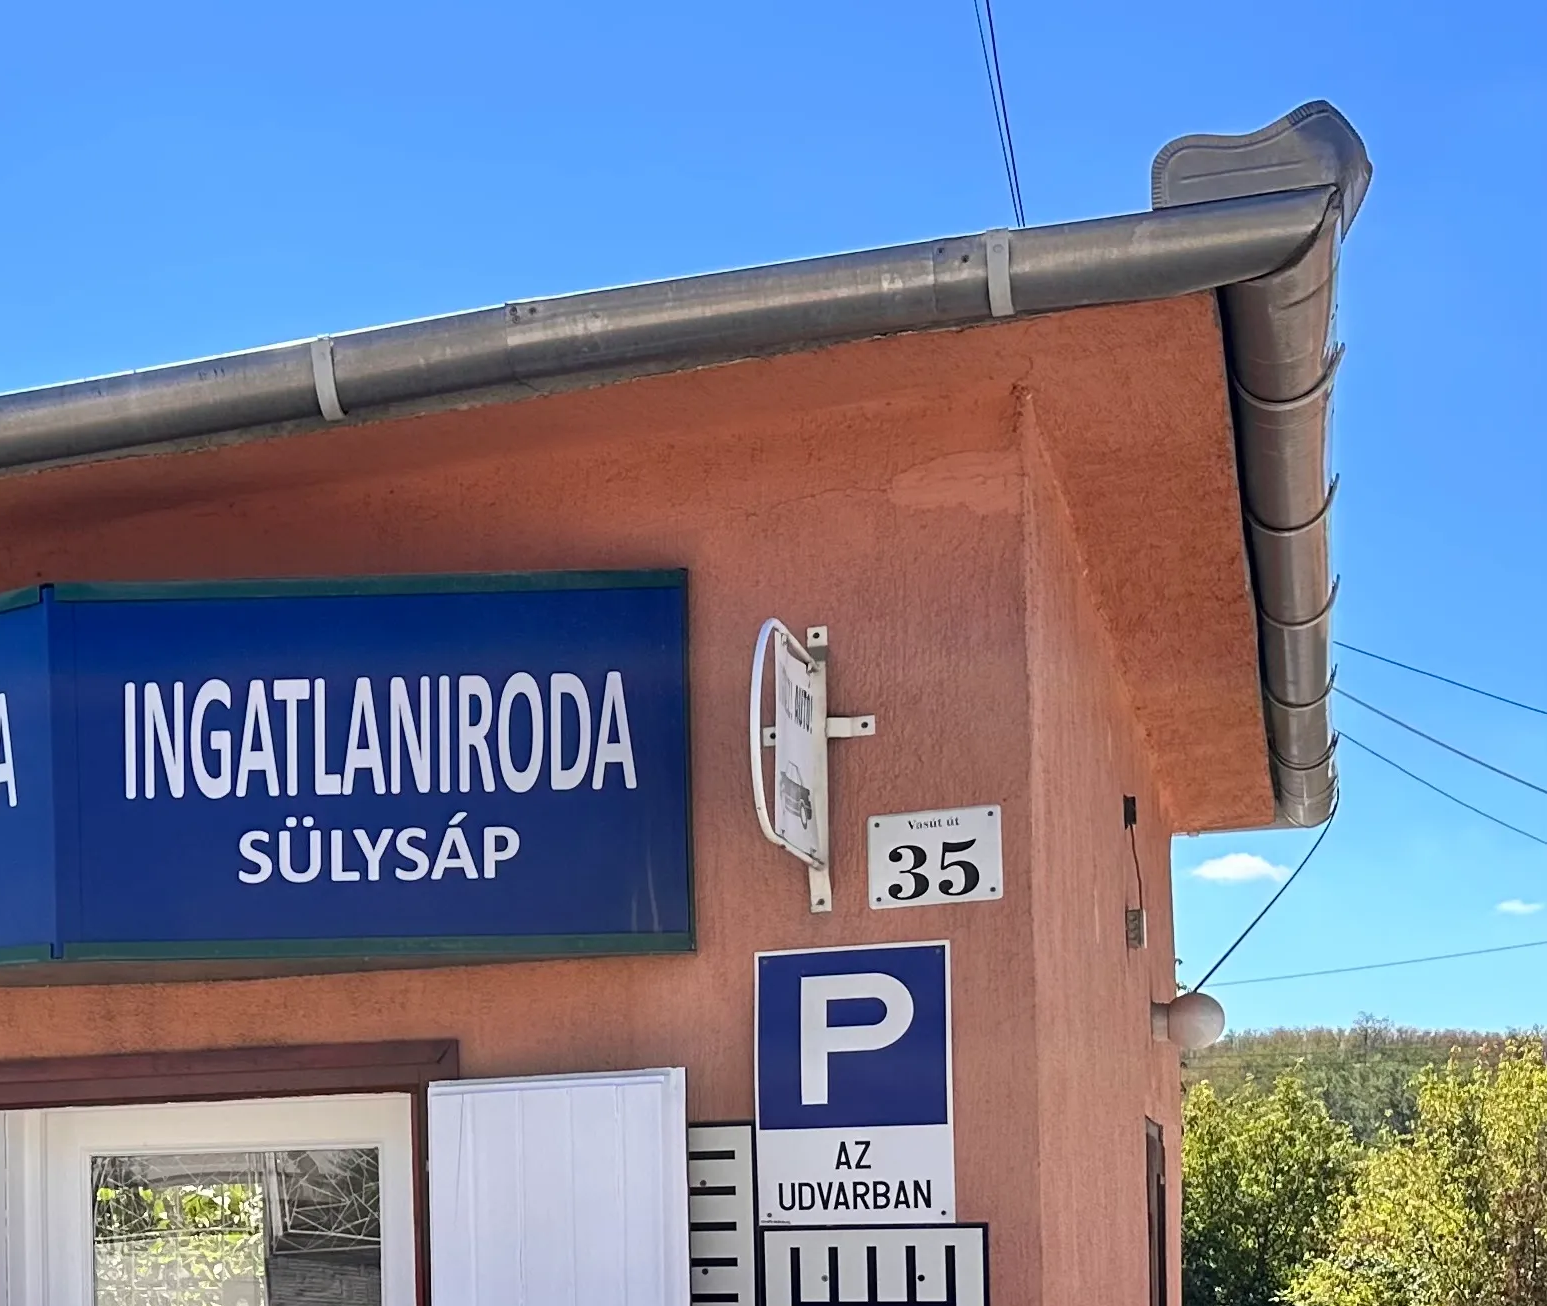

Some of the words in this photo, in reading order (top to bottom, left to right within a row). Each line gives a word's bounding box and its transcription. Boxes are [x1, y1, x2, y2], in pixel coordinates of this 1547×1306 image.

[124, 670, 638, 800] INGATLANIRODA
[236, 811, 521, 885] SÜLYSÁP
[908, 818, 943, 830] Vasút
[946, 816, 961, 827] út
[888, 838, 980, 900] 35
[800, 972, 914, 1105] P
[835, 1140, 872, 1170] AZ
[778, 1179, 932, 1211] UDVARBAN
